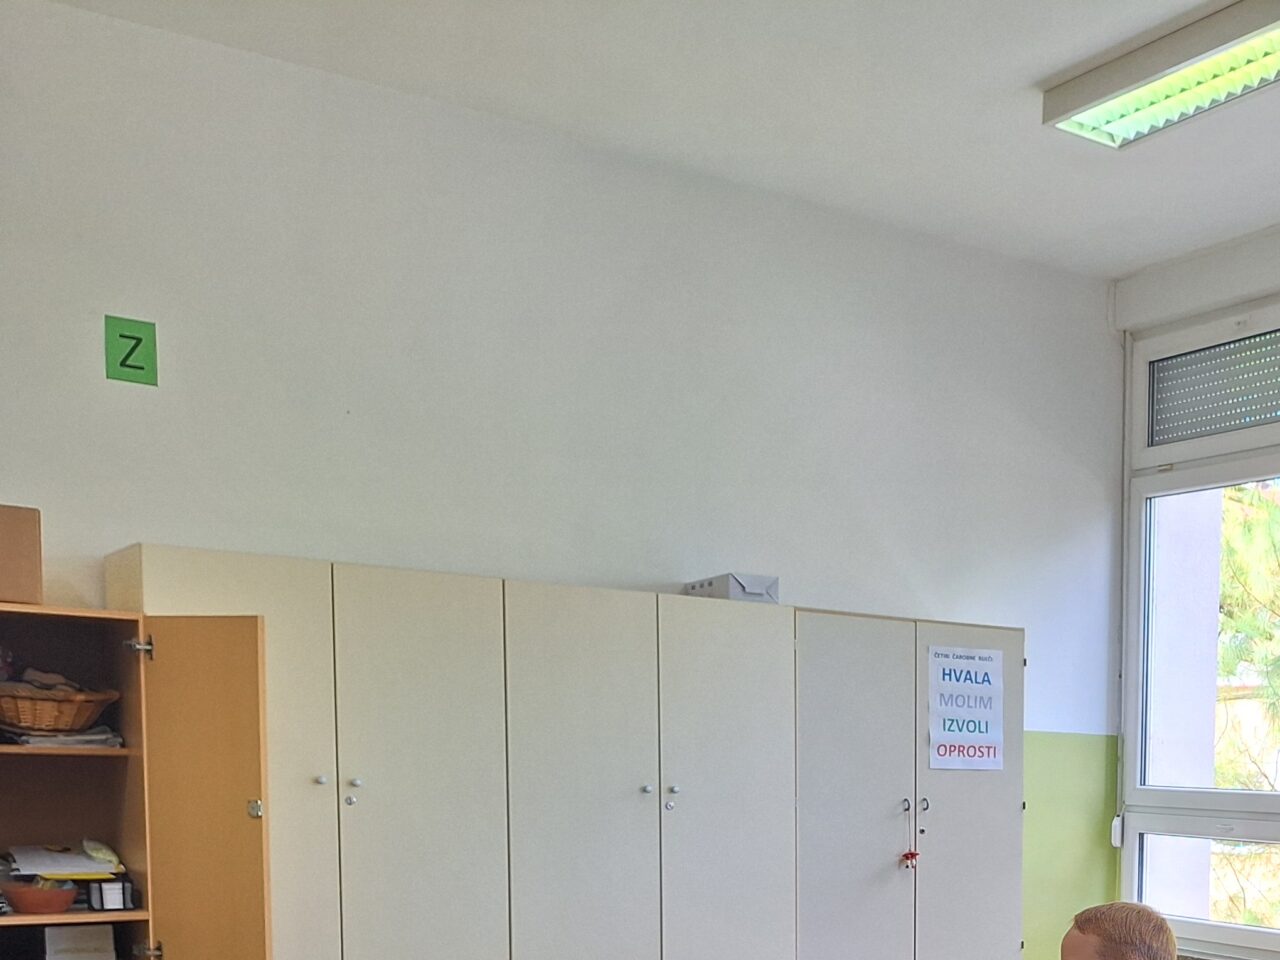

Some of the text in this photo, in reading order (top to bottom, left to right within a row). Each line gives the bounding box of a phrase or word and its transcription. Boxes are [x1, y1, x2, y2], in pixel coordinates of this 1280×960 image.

[118, 333, 145, 370] Z
[942, 667, 992, 686] HVALA
[939, 692, 993, 710] MOLIM
[942, 718, 989, 734] IZVOLI
[936, 744, 997, 759] OPROSTI
